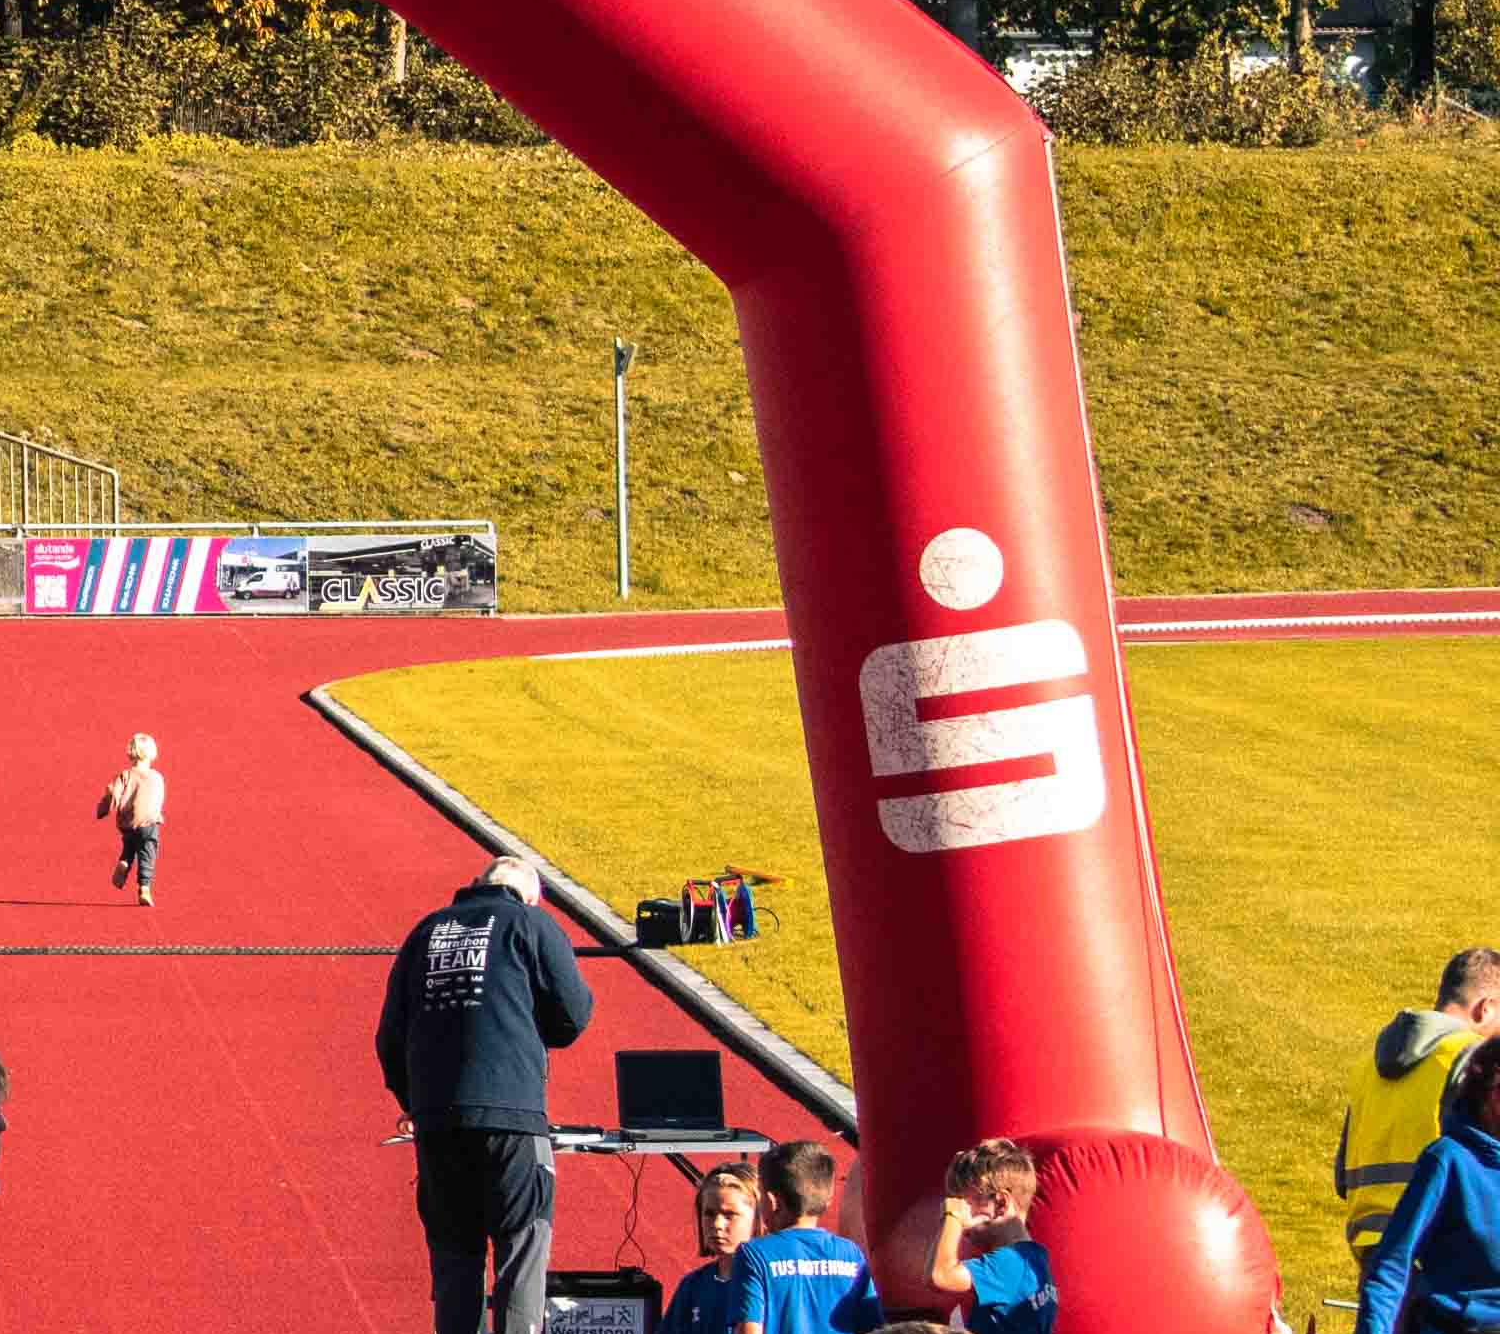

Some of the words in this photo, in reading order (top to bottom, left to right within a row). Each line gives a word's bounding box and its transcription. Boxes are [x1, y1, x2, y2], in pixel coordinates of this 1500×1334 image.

[420, 538, 456, 550] CLASSIC
[320, 575, 446, 607] CLASSIC
[428, 937, 489, 950] Marathon
[427, 949, 487, 971] TEAM
[770, 1259, 796, 1277] TUS
